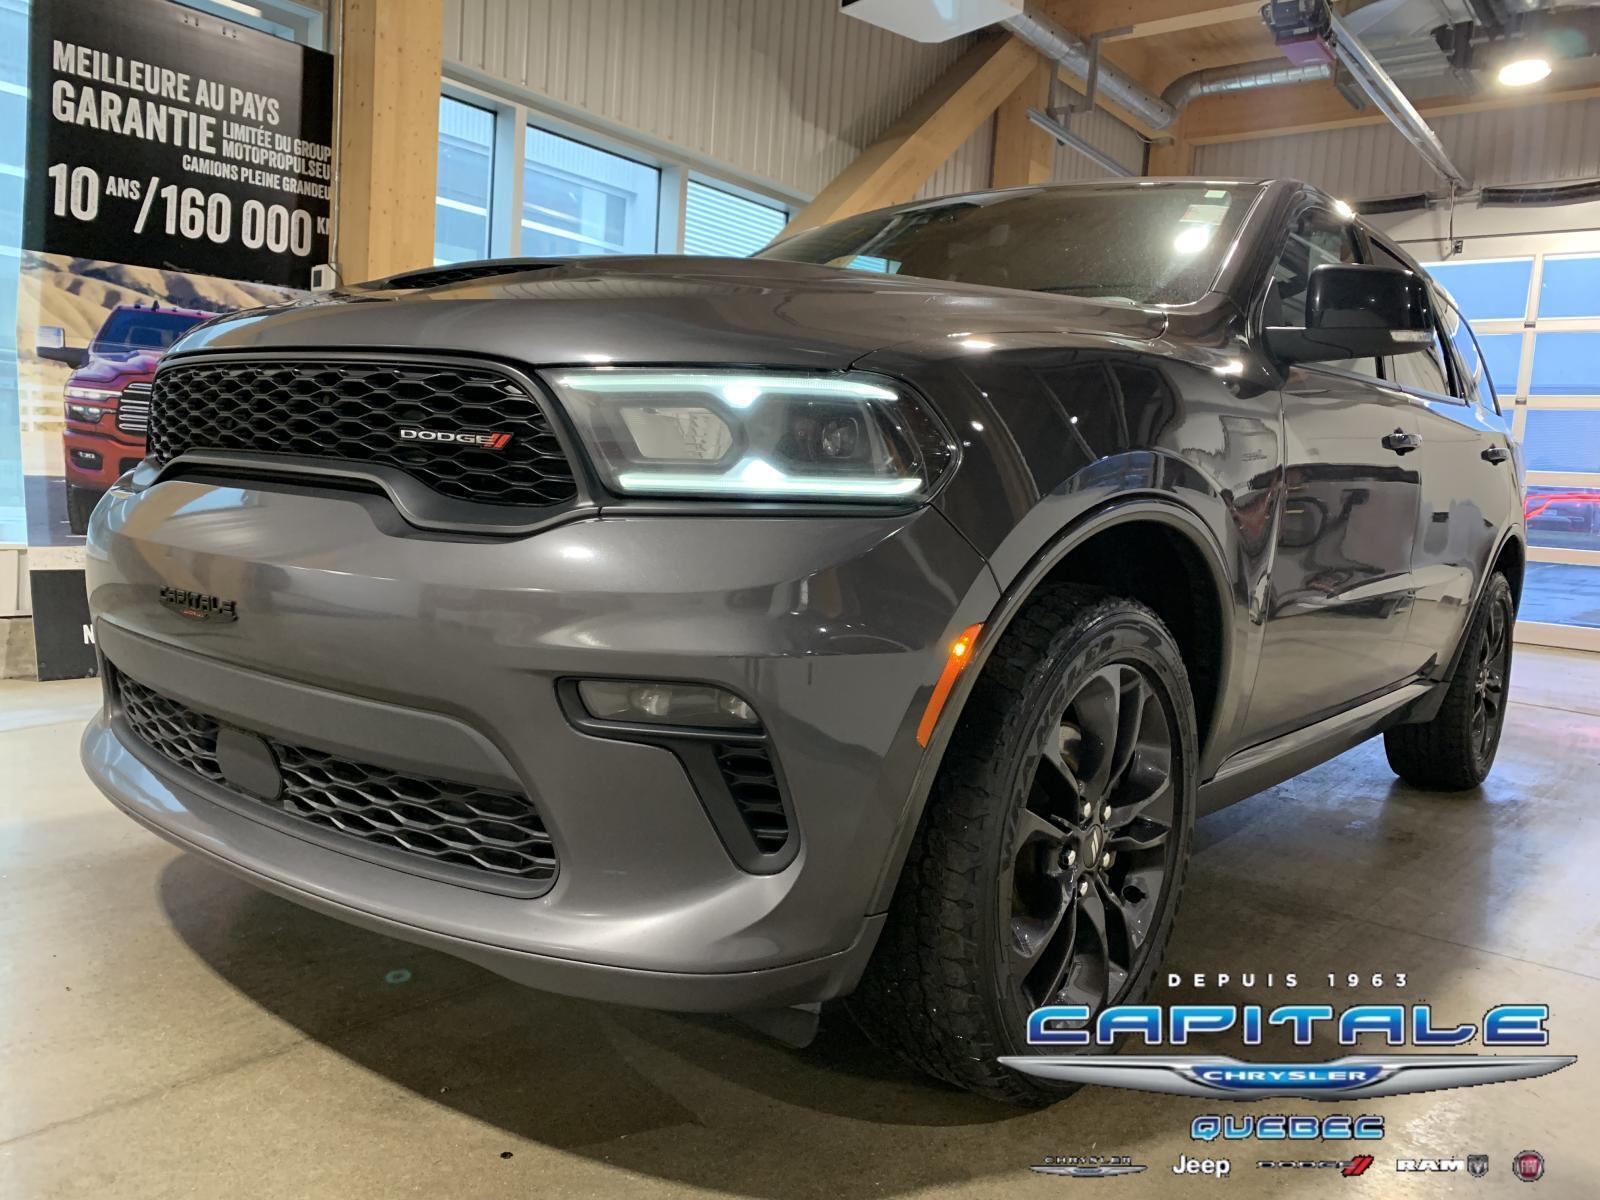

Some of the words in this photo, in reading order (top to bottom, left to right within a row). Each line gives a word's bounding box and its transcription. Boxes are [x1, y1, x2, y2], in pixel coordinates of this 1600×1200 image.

[52, 39, 191, 103] MEILLEURE
[195, 78, 225, 111] AU
[230, 87, 280, 126] PAYS
[52, 79, 217, 154] GARANTIE
[222, 119, 273, 149] LIMITÉE
[274, 133, 292, 153] DU
[182, 154, 239, 181] CAMIONS
[240, 166, 281, 190] PLEINE
[48, 162, 99, 222] 10
[105, 176, 141, 201] ANS
[241, 199, 312, 257] 000
[400, 429, 495, 446] DODGE
